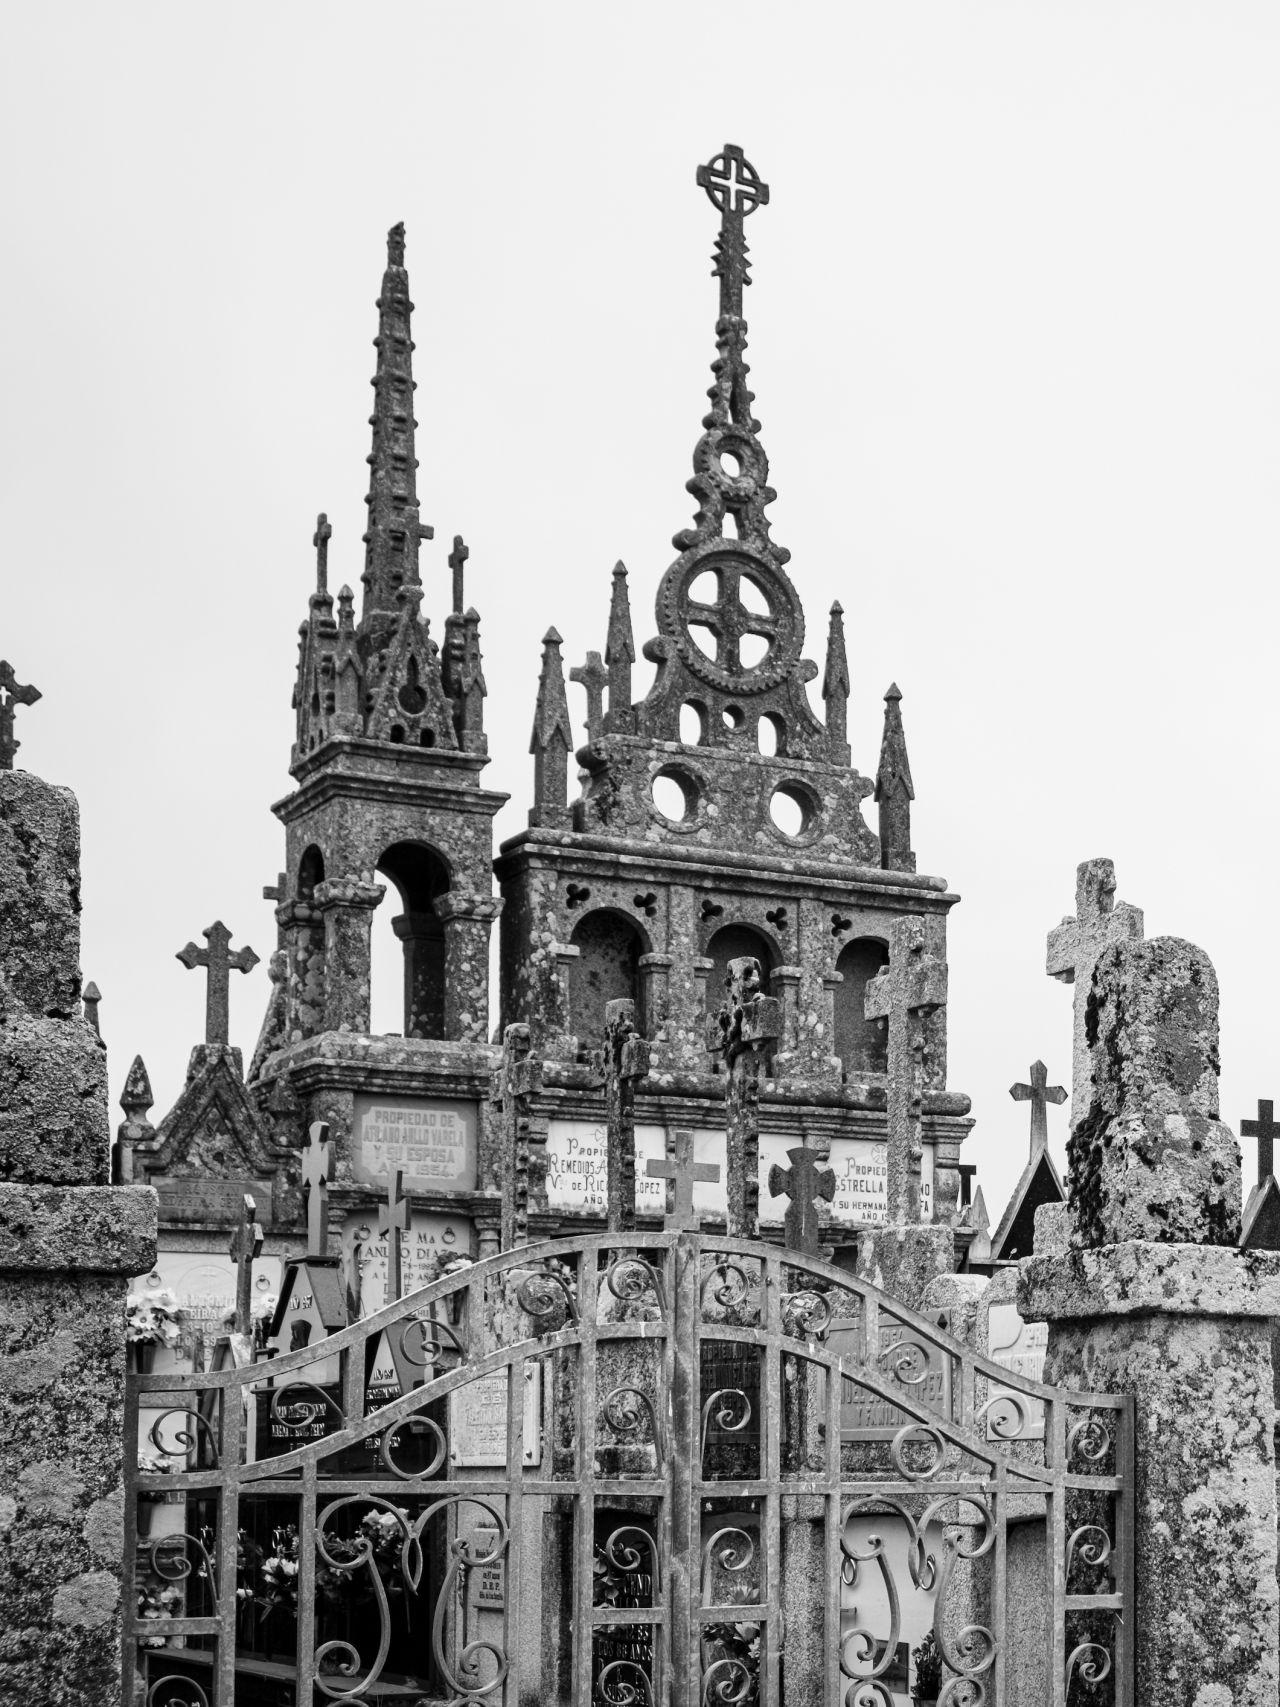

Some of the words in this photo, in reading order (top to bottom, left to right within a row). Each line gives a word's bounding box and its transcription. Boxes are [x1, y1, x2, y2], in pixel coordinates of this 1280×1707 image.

[374, 1110, 436, 1126] PROPIEDAD
[440, 1115, 455, 1127] DE
[839, 1201, 849, 1209] SU
[862, 1211, 878, 1221] AÑO
